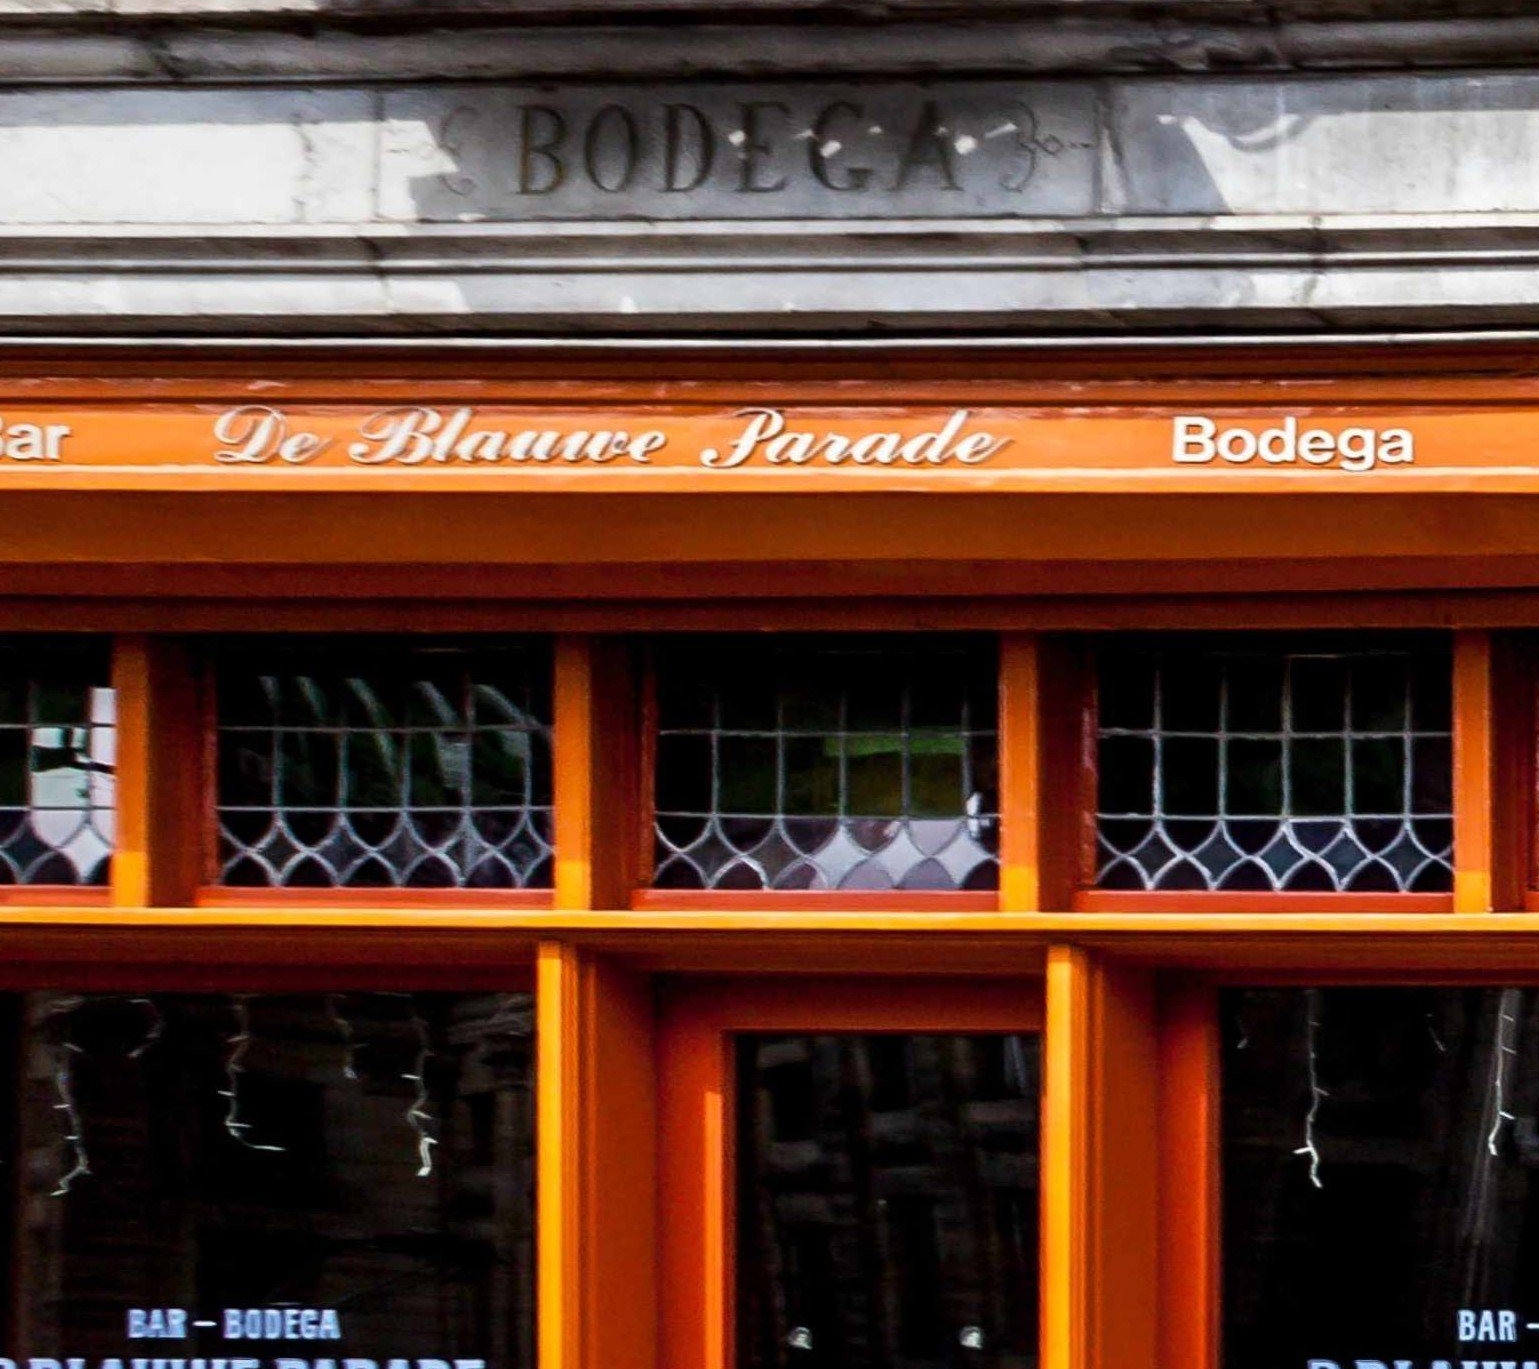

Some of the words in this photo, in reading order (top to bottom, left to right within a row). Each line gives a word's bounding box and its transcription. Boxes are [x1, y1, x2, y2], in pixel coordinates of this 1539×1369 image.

[514, 99, 966, 195] BODEGA
[0, 416, 73, 461] ar
[212, 404, 338, 464] De
[347, 404, 668, 466] Blauwe
[700, 406, 1015, 469] Parade
[1172, 415, 1415, 472] Bodega
[127, 1308, 188, 1339] BAR
[223, 1308, 342, 1340] BODEGA
[1458, 1309, 1518, 1342] BAR
